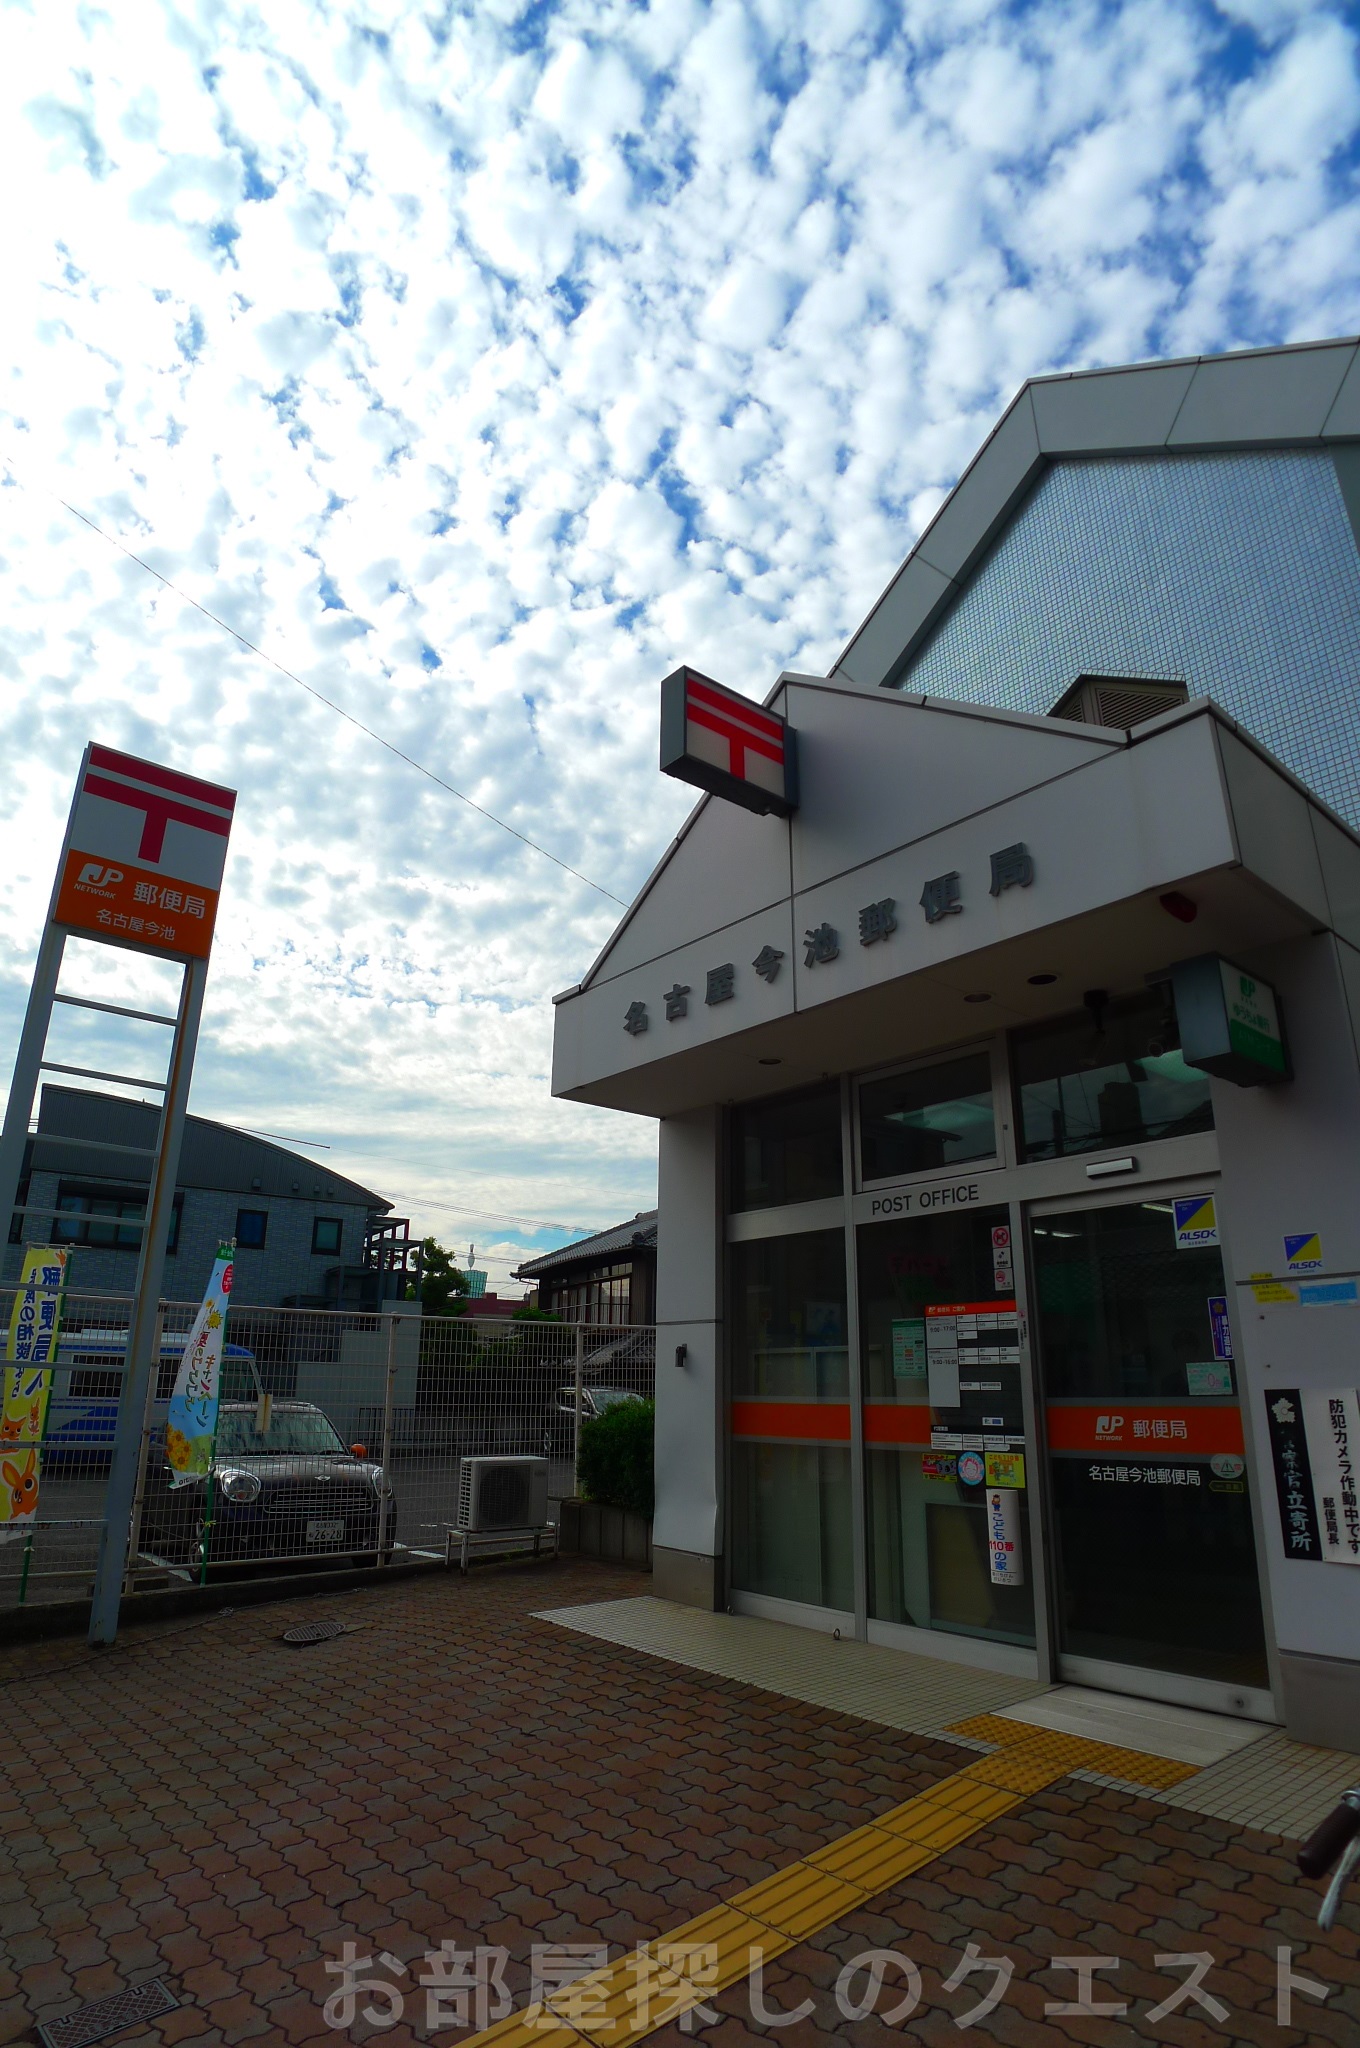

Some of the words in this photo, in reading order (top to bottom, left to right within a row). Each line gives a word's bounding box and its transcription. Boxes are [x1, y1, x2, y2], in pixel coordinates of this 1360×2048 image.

[78, 862, 125, 887] JP
[73, 883, 117, 905] NETWORK
[133, 881, 206, 920] 郵便局
[95, 908, 176, 942] 名古屋今池
[872, 1194, 912, 1216] POST
[919, 1184, 980, 1209] OFFICE
[1178, 1229, 1216, 1241] ALSOK
[1288, 1260, 1323, 1270] ALSOK
[1095, 1415, 1124, 1434] JP
[1132, 1418, 1188, 1440] 郵便局
[1094, 1434, 1123, 1442] NETWORK
[1088, 1464, 1202, 1487] 名古屋今池郵便局
[1328, 1398, 1360, 1554] 防犯カメラ作動中です
[1323, 1497, 1340, 1545] 郵便局長
